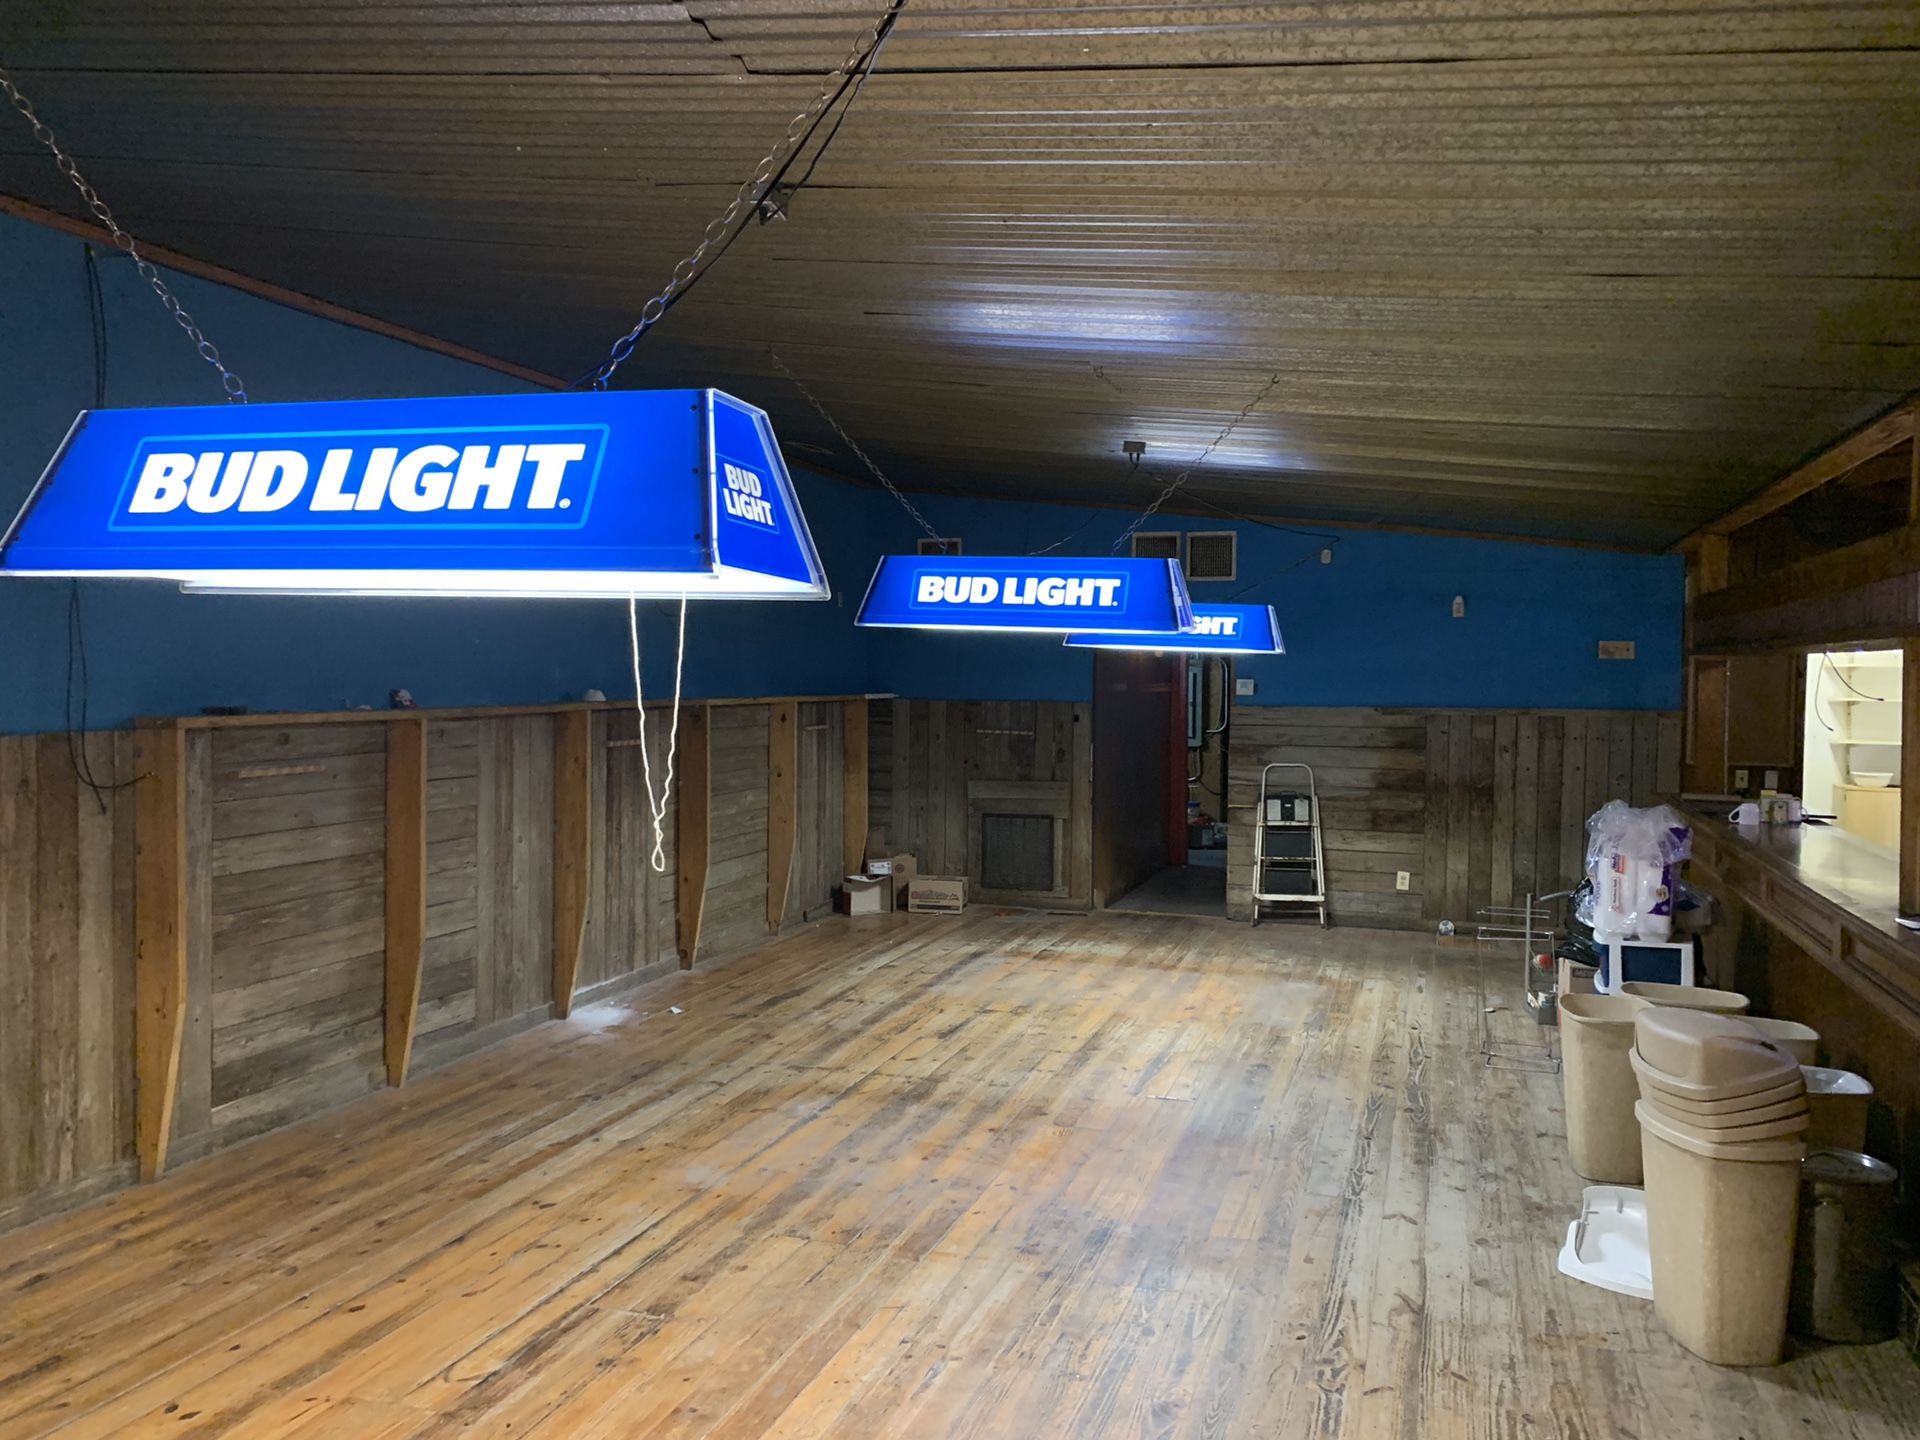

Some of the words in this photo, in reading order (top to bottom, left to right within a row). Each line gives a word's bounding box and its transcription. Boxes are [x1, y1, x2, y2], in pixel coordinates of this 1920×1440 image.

[128, 450, 309, 514] BUD
[309, 443, 586, 512] LIGHT
[723, 463, 762, 498] BUD
[722, 487, 774, 526] LIGHT
[917, 575, 999, 604] BUD
[1003, 577, 1122, 607] LIGHT
